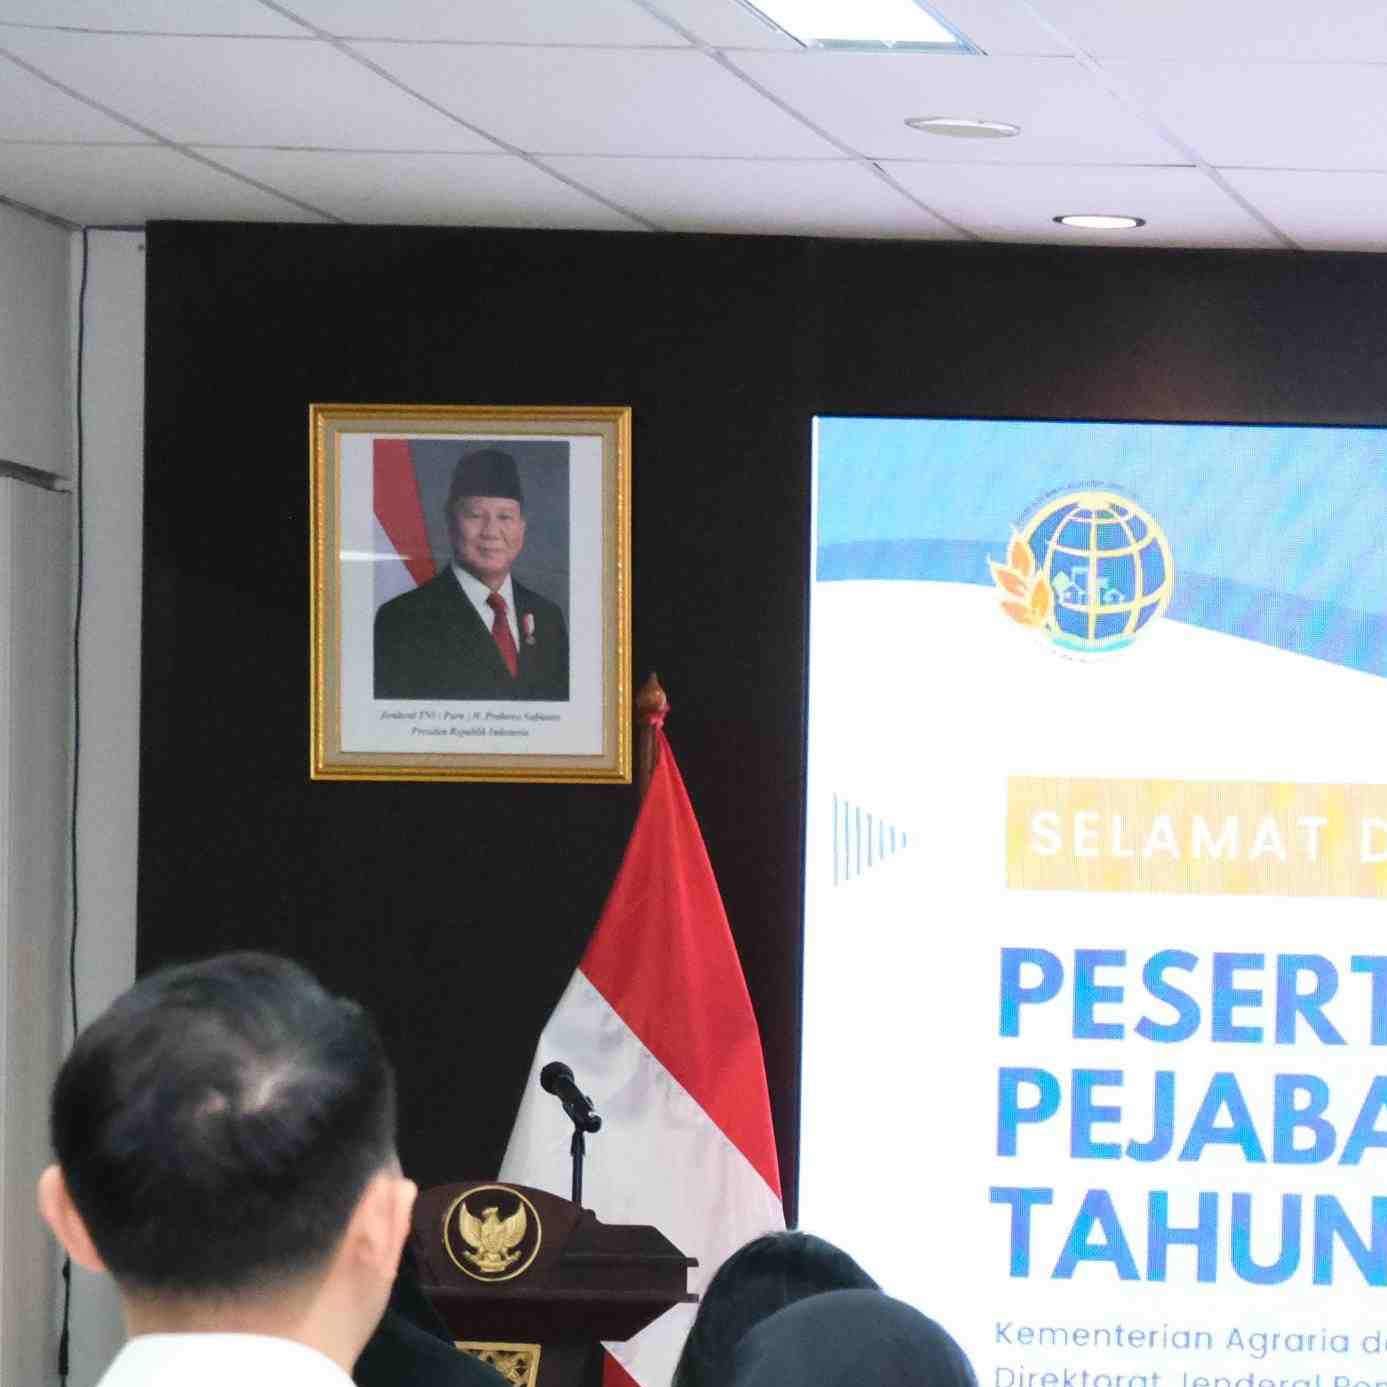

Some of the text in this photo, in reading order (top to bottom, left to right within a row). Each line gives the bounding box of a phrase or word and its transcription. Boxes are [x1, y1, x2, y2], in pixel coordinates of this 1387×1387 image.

[1030, 810, 1329, 861] SELAMAT
[995, 1321, 1214, 1351] Kementerian
[1226, 1328, 1351, 1358] Agraria
